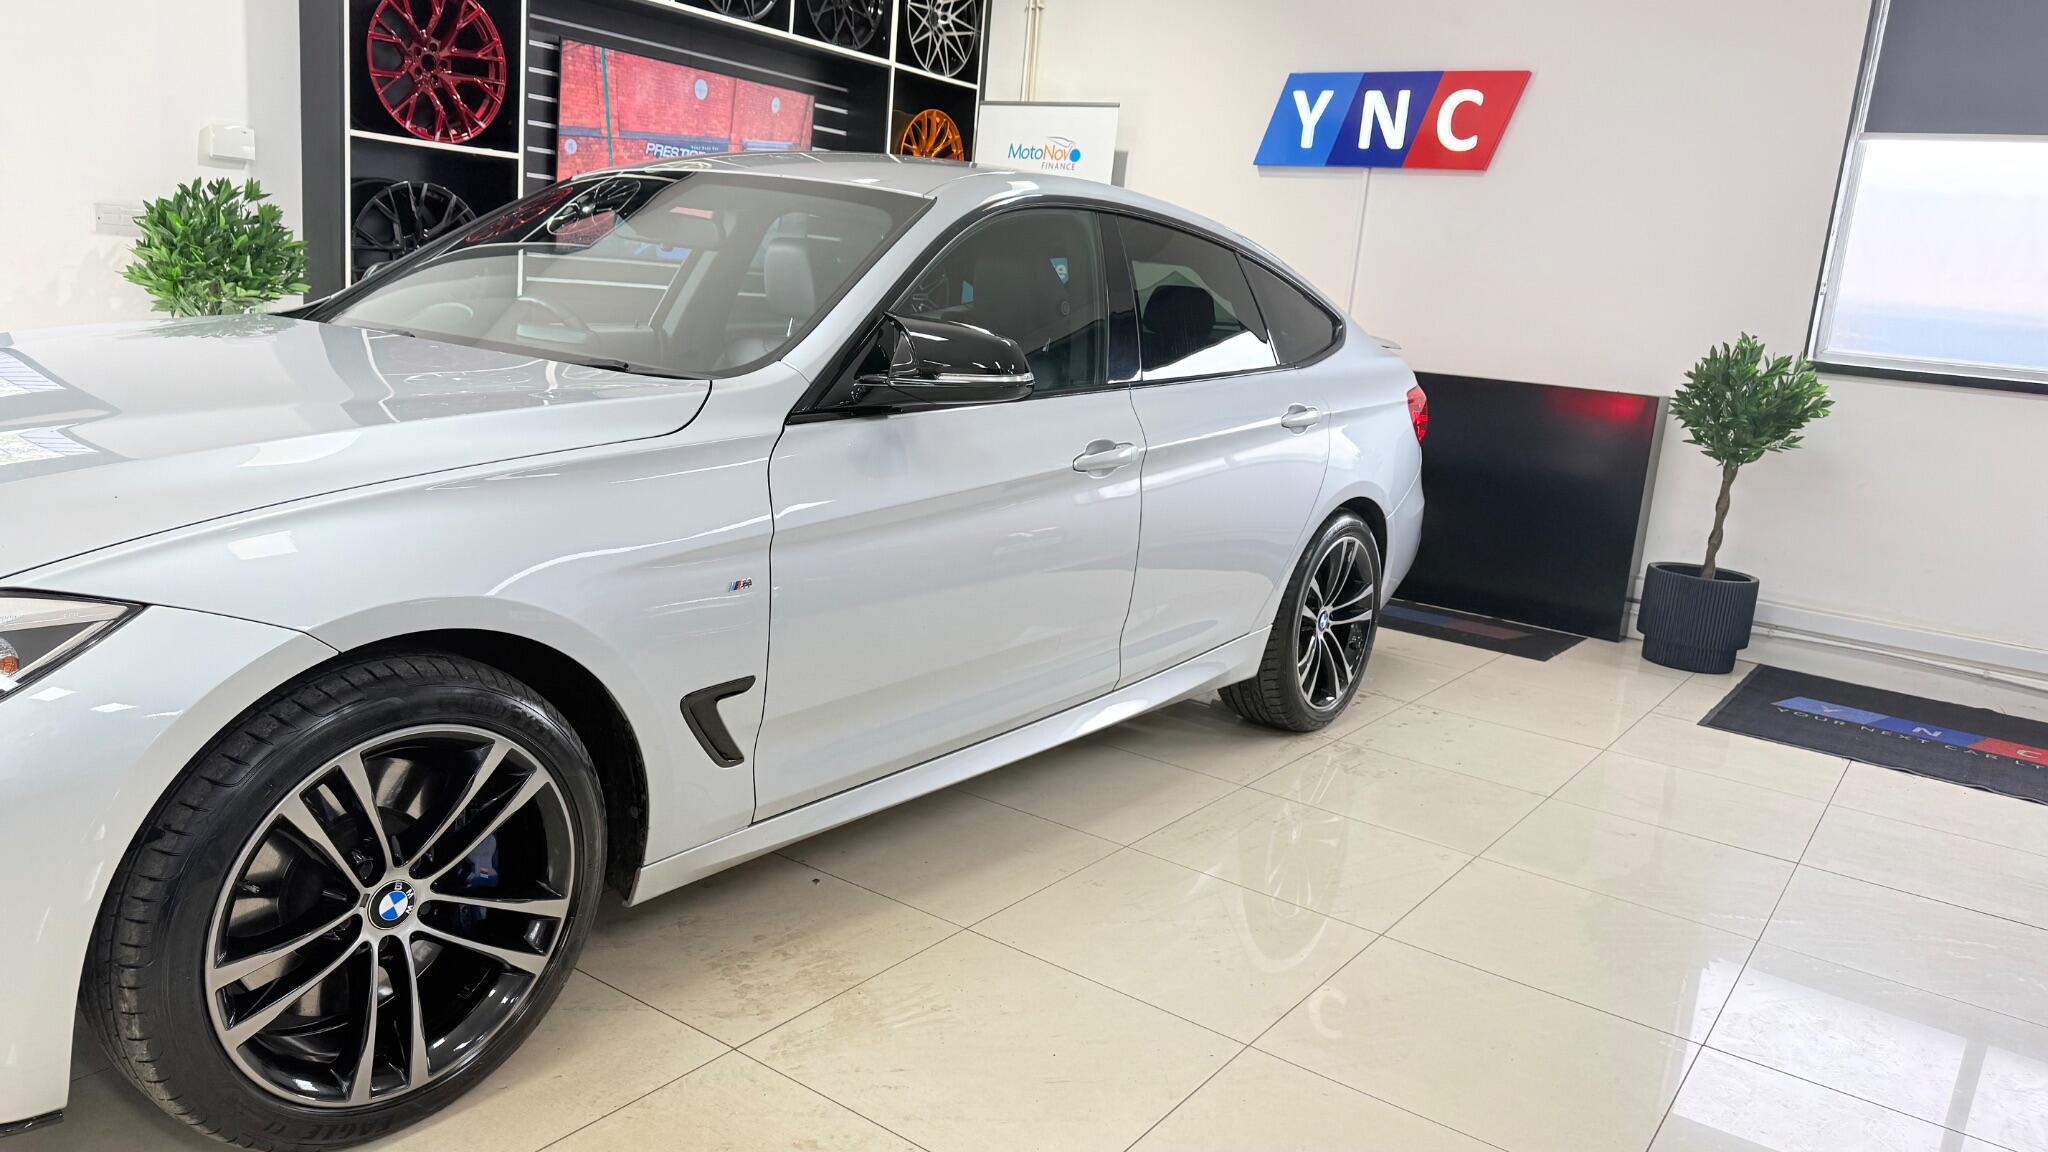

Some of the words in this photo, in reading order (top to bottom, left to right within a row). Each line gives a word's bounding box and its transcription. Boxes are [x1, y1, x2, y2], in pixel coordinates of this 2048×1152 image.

[1293, 88, 1484, 152] YNC
[645, 142, 706, 158] PRESTI
[1007, 143, 1081, 162] MotoNovo
[1041, 161, 1076, 171] FINANCE
[1777, 706, 1845, 726] YOUR
[1860, 725, 1930, 744] NEXT
[1944, 744, 1998, 760] CAR
[394, 881, 415, 914] BMW
